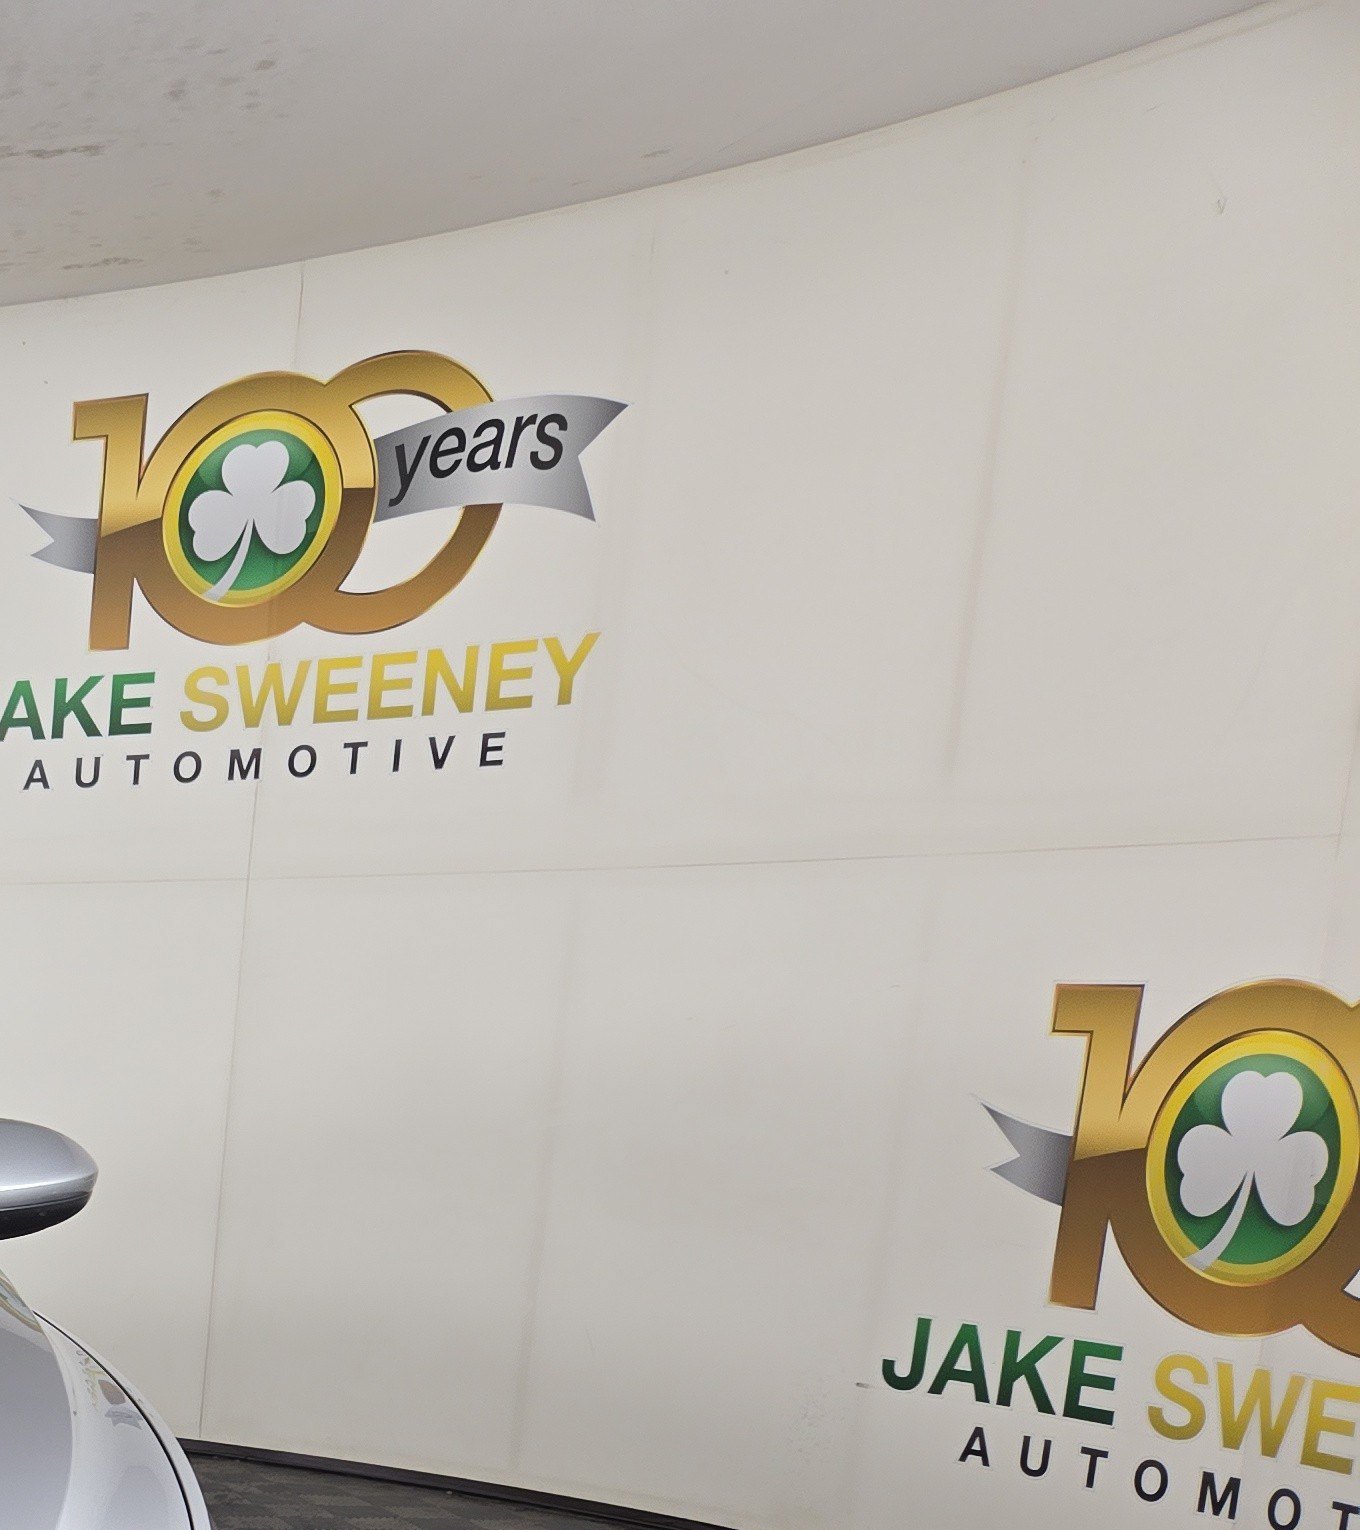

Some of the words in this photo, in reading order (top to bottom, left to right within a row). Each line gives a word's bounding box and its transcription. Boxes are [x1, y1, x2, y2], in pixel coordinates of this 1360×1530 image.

[71, 349, 504, 653] 100
[387, 411, 568, 507] years
[179, 632, 601, 734] SWEENEY
[23, 731, 507, 791] AUTOMOTIVE
[881, 1316, 1124, 1427] JAKE
[1148, 1353, 1360, 1476] SWE
